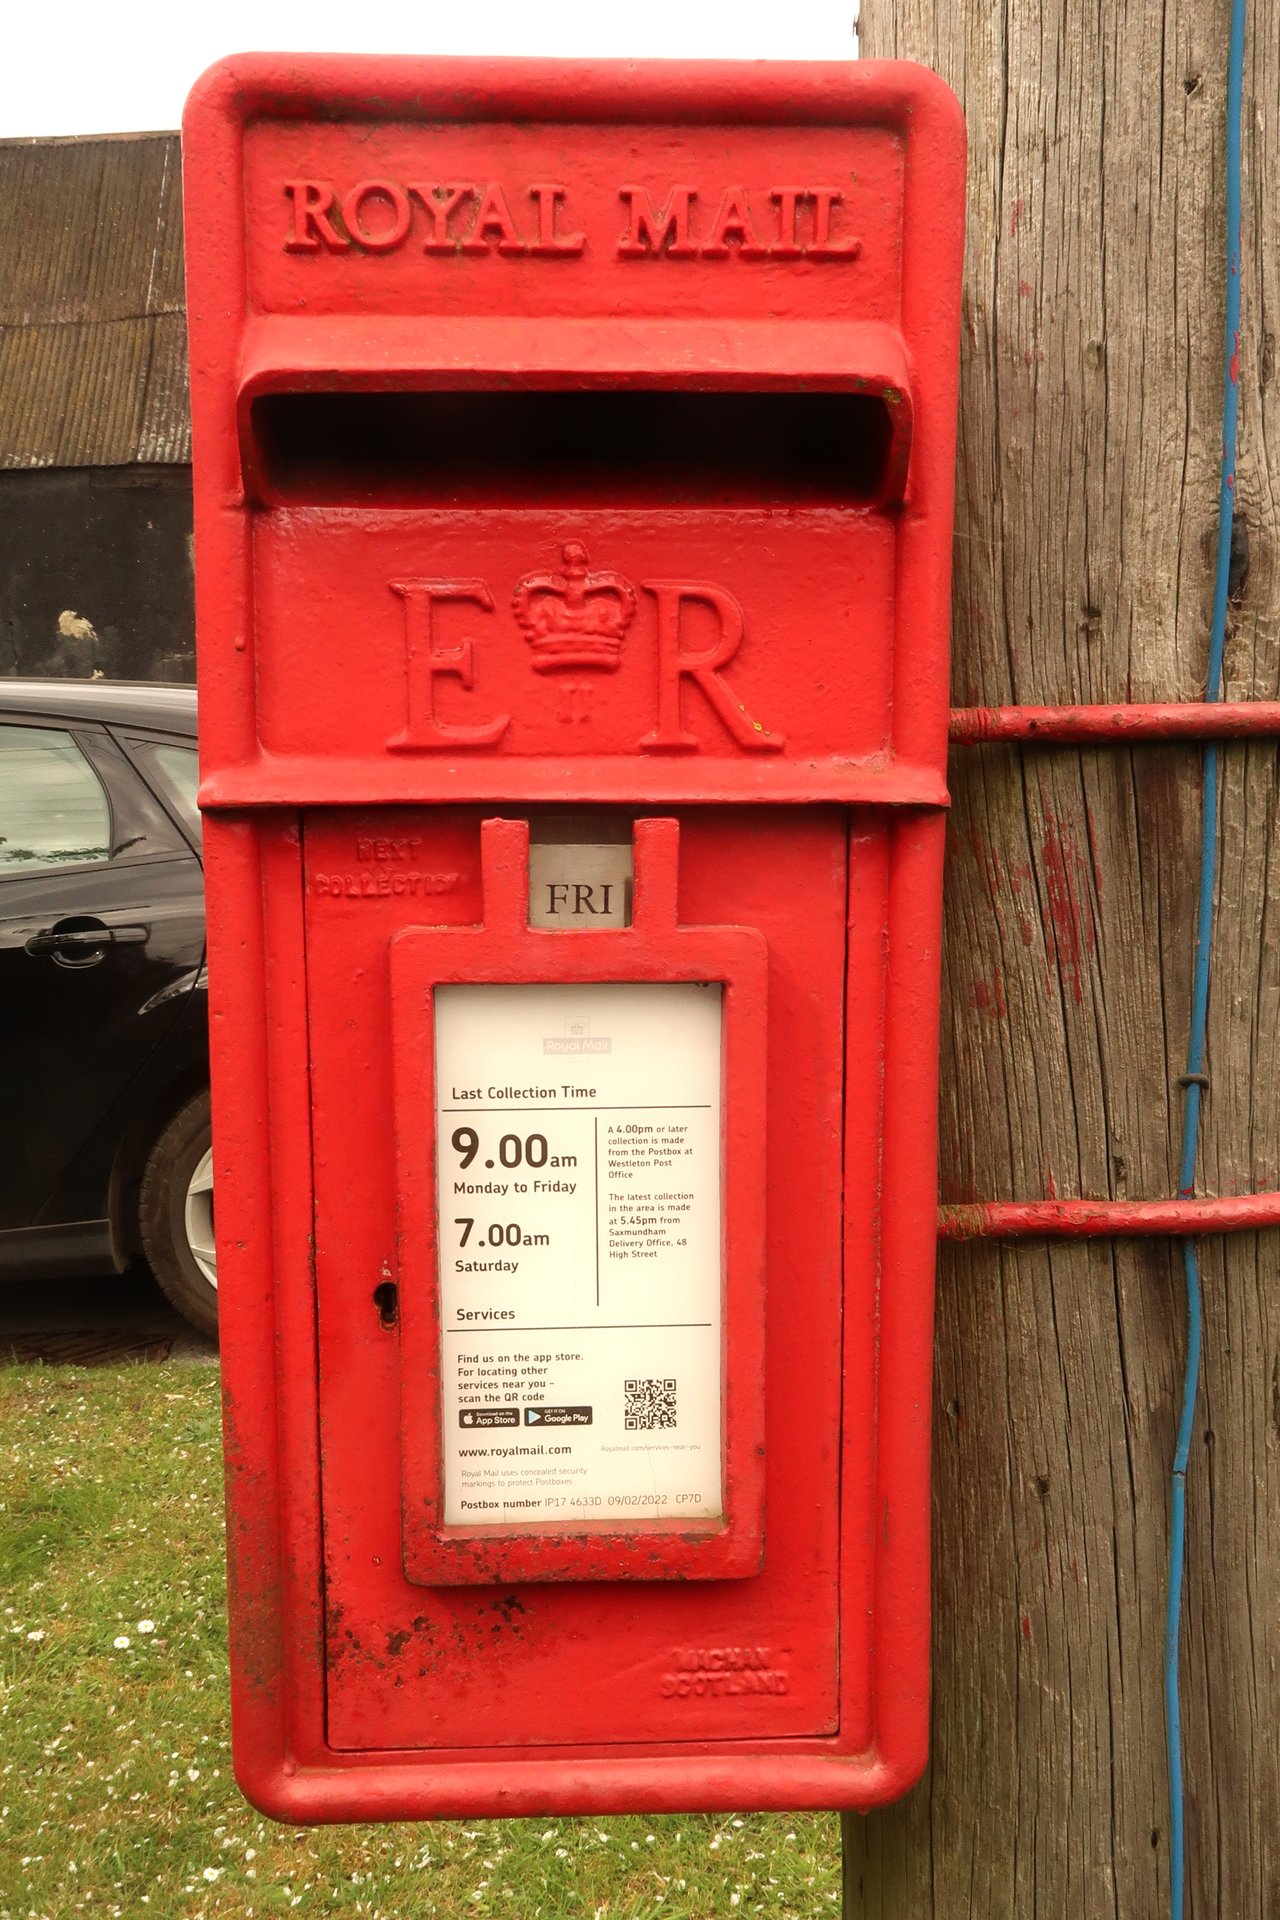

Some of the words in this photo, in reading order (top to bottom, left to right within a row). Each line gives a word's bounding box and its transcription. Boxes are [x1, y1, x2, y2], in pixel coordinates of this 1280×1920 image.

[282, 179, 586, 259] ROYAL
[616, 182, 861, 261] MAIL
[386, 576, 510, 754] E
[638, 578, 786, 753] R
[357, 837, 422, 862] NEXT
[545, 883, 614, 915] FRI
[546, 1040, 580, 1054] Royal
[581, 1039, 608, 1051] Mail
[453, 1087, 482, 1100] Last
[488, 1086, 556, 1099] Collection
[561, 1086, 596, 1098] Time
[617, 1125, 653, 1135] 4.00pm
[608, 1137, 648, 1145] collection
[652, 1136, 658, 1144] is
[661, 1136, 684, 1144] made
[451, 1127, 577, 1169] 9.00am
[454, 1182, 508, 1196] Monday
[514, 1182, 527, 1193] to
[534, 1180, 576, 1194] Friday
[654, 1192, 694, 1200] collection
[668, 1203, 690, 1211] made
[621, 1216, 657, 1226] 5.45pm
[454, 1218, 549, 1248] 7.00am
[609, 1228, 666, 1236] Saxmundham
[609, 1240, 643, 1248] Delivery
[610, 1251, 628, 1259] High
[632, 1250, 657, 1258] Street
[455, 1260, 518, 1273] Saturday
[457, 1308, 515, 1321] Services
[458, 1355, 479, 1363] Find
[514, 1354, 529, 1362] the
[534, 1355, 551, 1363] app
[555, 1353, 583, 1361] store.
[458, 1368, 474, 1376] For
[478, 1367, 517, 1377] locating
[521, 1366, 548, 1375] other
[458, 1380, 498, 1390] services
[528, 1381, 545, 1389] you
[484, 1394, 500, 1402] the
[505, 1393, 518, 1401] QR
[522, 1392, 544, 1401] code
[476, 1417, 493, 1425] App
[494, 1416, 516, 1424] Store
[544, 1414, 572, 1424] Google
[572, 1413, 589, 1423] Play
[459, 1445, 571, 1458] www.royalmail.com
[461, 1469, 482, 1478] Royal
[483, 1468, 500, 1477] Mail
[520, 1467, 557, 1476] concealed
[558, 1467, 588, 1476] security
[461, 1479, 496, 1488] markings
[497, 1479, 506, 1487] to
[507, 1478, 534, 1488] protect
[536, 1477, 573, 1486] Postboxes
[460, 1500, 500, 1510] Postbox
[503, 1498, 542, 1509] number
[544, 1497, 567, 1507] IP17
[569, 1496, 602, 1507] 4633D
[607, 1495, 668, 1506] 09/02/2022
[675, 1493, 702, 1505] CP7D
